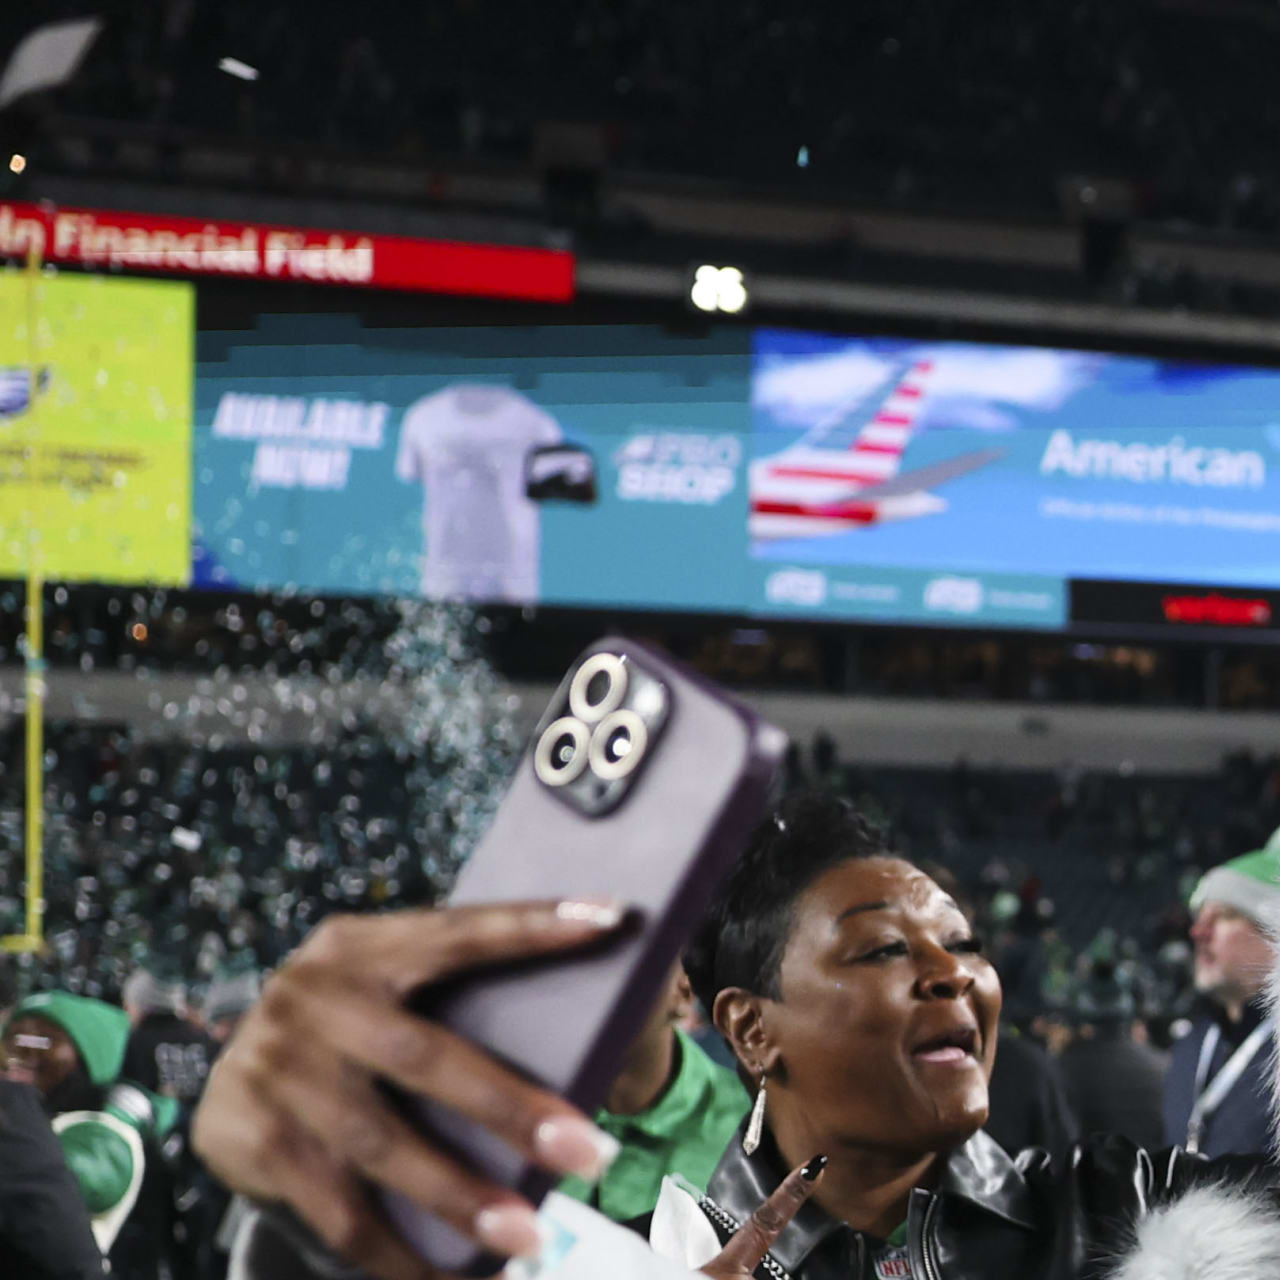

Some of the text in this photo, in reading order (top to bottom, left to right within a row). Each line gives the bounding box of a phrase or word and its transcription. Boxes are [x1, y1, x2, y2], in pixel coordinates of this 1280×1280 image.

[54, 212, 261, 276] Financial
[265, 230, 374, 284] Field
[1041, 430, 1266, 490] American
